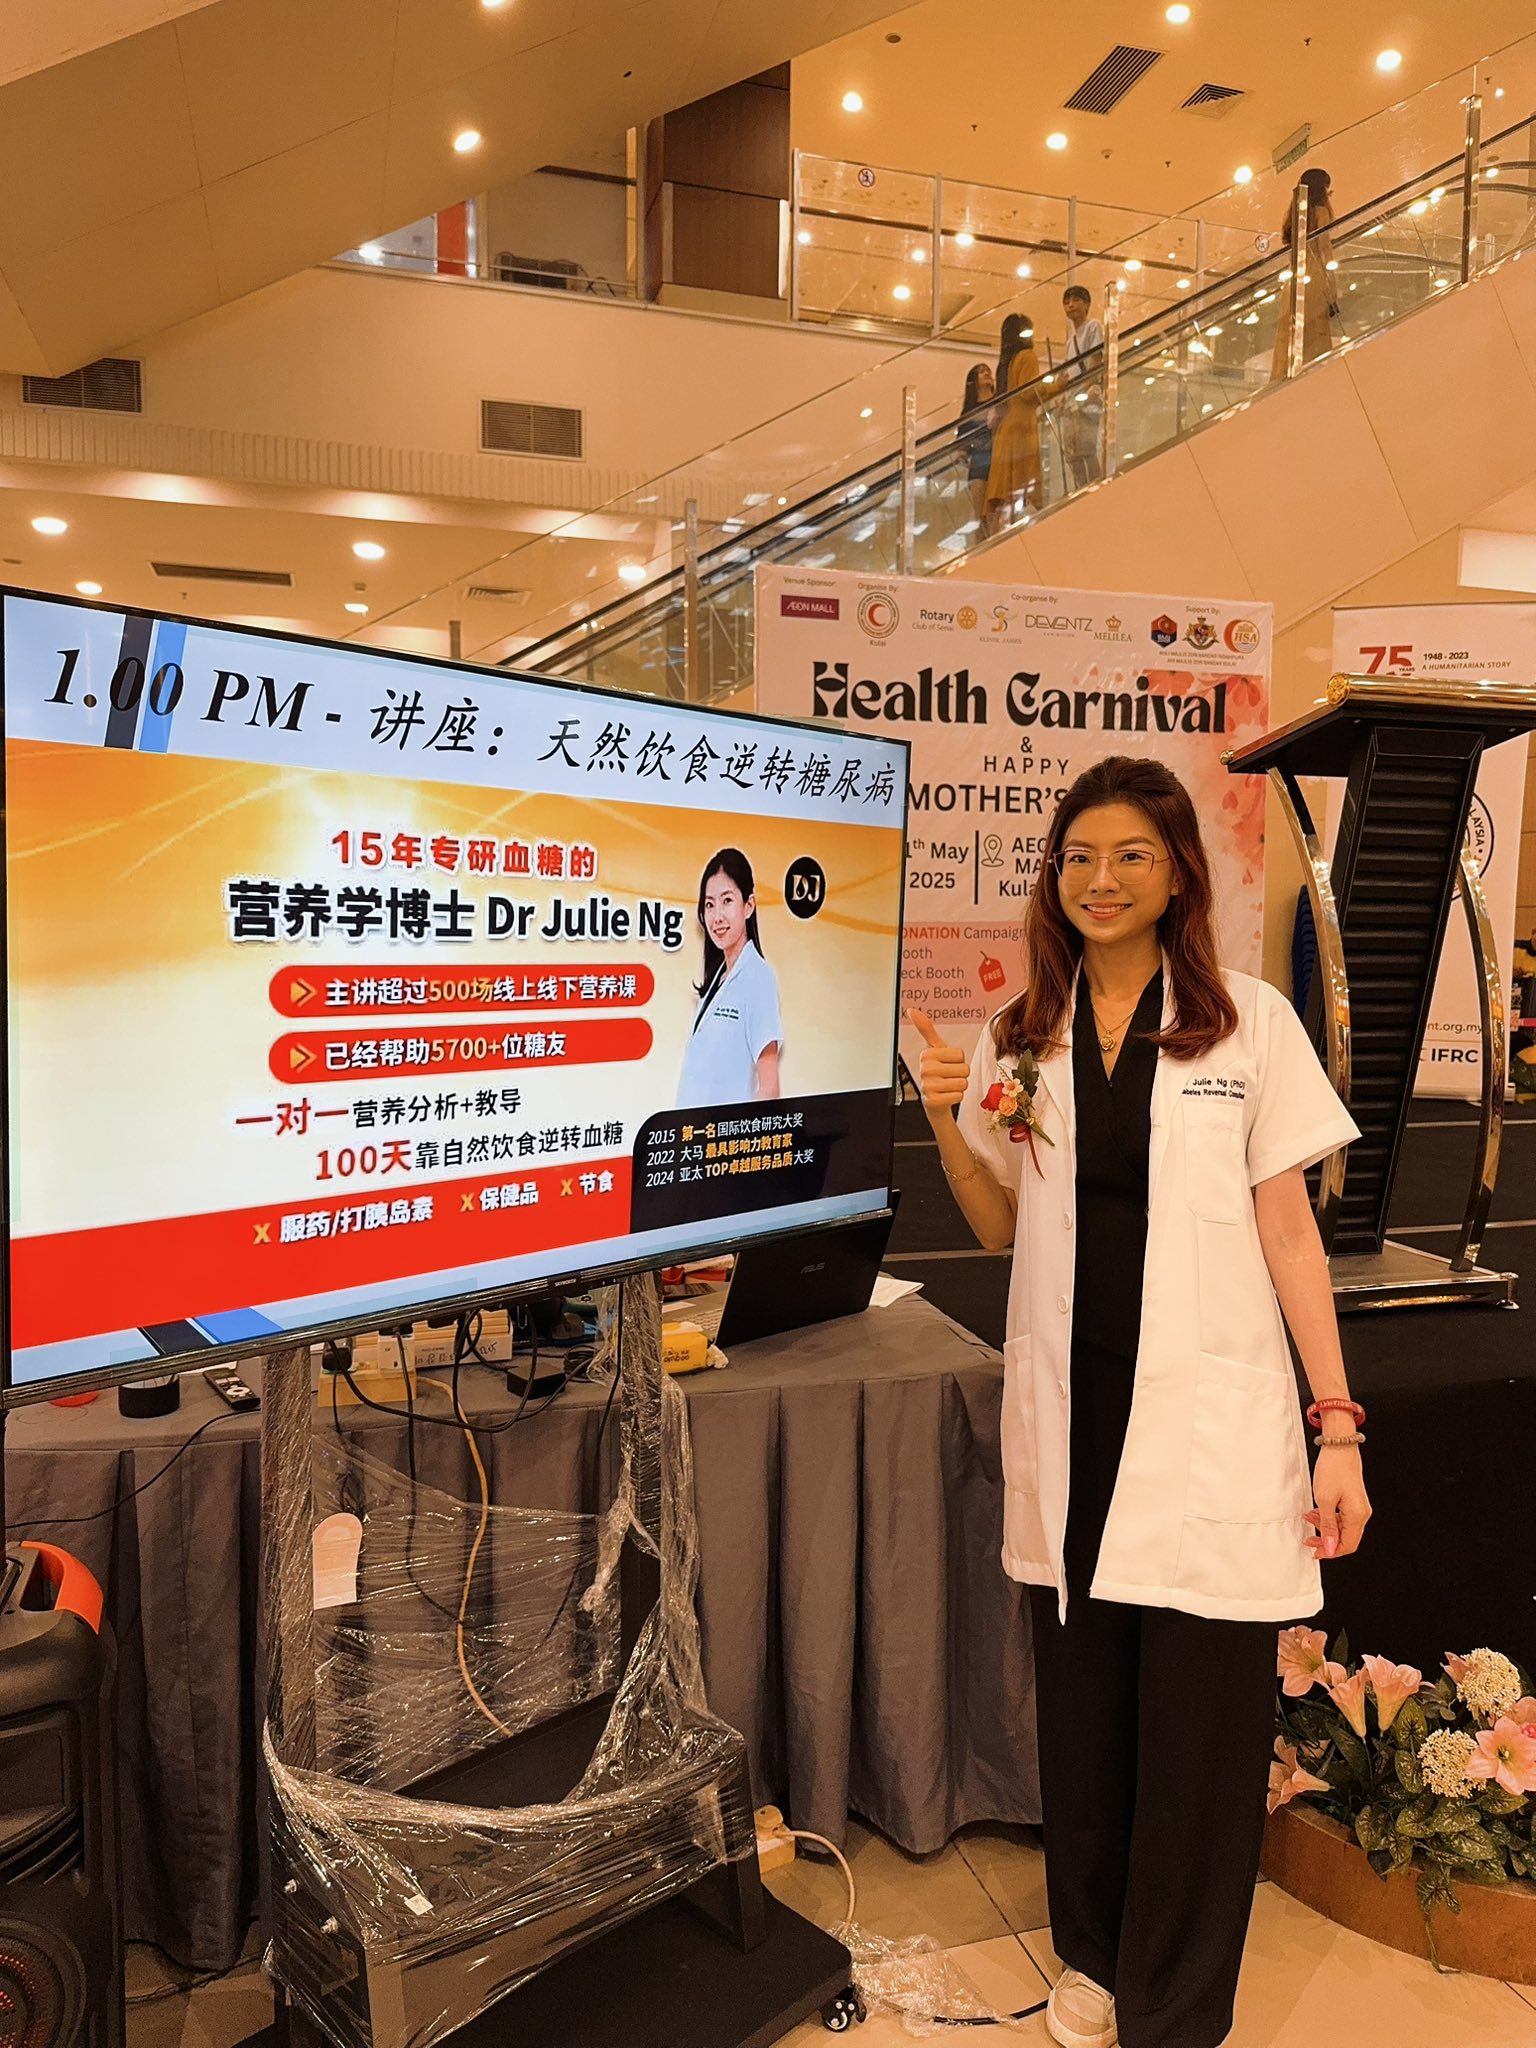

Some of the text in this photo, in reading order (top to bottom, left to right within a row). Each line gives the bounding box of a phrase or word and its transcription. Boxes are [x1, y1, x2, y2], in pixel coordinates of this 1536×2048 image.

[811, 602, 835, 614] MALL
[919, 609, 955, 623] Rotary
[911, 622, 927, 630] Club
[1024, 614, 1093, 632] DEVENTZ
[1093, 632, 1133, 643] MELILEA
[1234, 632, 1258, 643] HSA
[1423, 653, 1443, 661] 1948
[1449, 652, 1469, 660] 2023
[1487, 661, 1511, 669] STORY
[44, 648, 185, 717] 1.00
[200, 669, 315, 732] PM
[813, 661, 1226, 734] Health Carnival
[1020, 736, 1032, 753] &
[984, 756, 1069, 776] HAPPY
[331, 830, 597, 878] 15年专研血糖的
[931, 842, 969, 864] May
[909, 872, 955, 889] 2025
[228, 880, 685, 947] 营养学博士 Dr Julie Ng
[926, 967, 964, 979] Booth
[983, 968, 1003, 983] FREE
[325, 975, 637, 1007] 主讲超过500场线上线下营养课
[933, 986, 972, 999] Booth
[926, 1006, 986, 1020] speakers)
[324, 1030, 567, 1071] 已经帮助5700+位糖友
[1431, 1048, 1479, 1063] IFRC
[1192, 1077, 1212, 1086] Julie
[1216, 1078, 1227, 1088] Ng
[235, 1088, 521, 1136] 一对一营养分析+教导
[646, 1128, 676, 1146] 2015
[315, 1120, 624, 1181] 100天靠自然饮食逆转血糖
[646, 1149, 675, 1166] 2022
[645, 1170, 675, 1187] 2024
[479, 1180, 540, 1211] 保健品
[578, 1169, 615, 1195] 节食
[799, 1262, 825, 1274] ASUS
